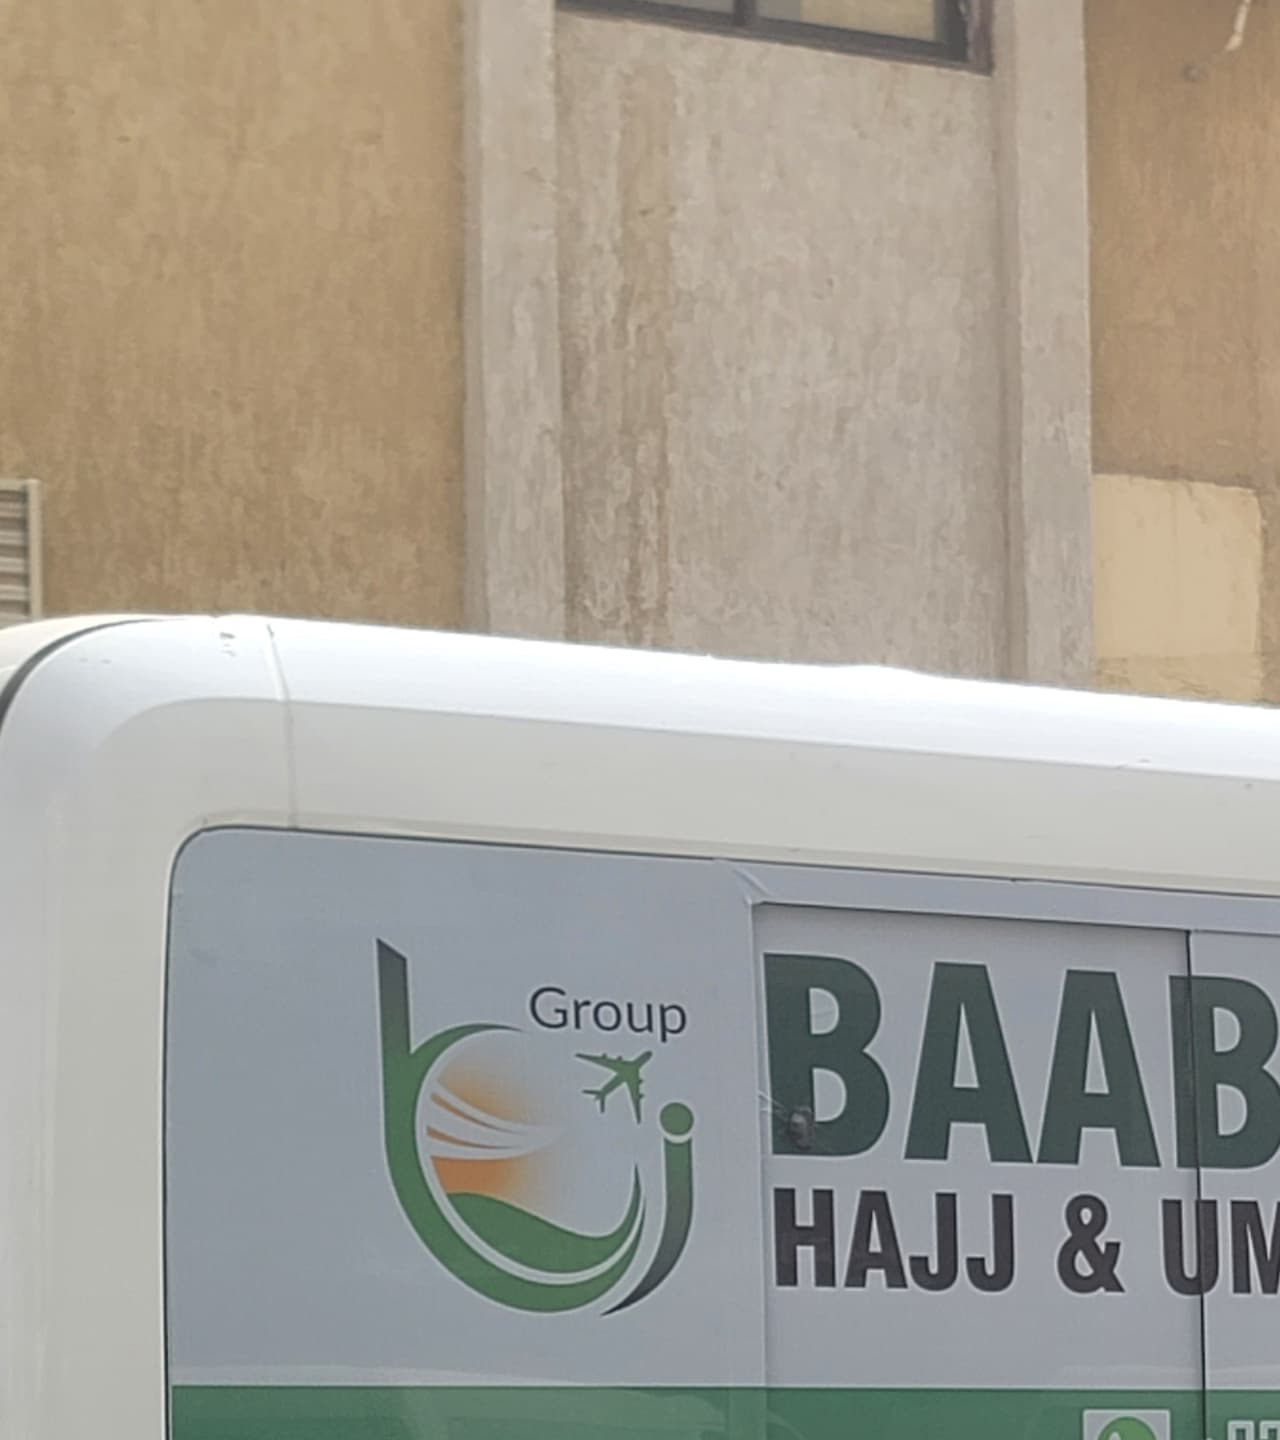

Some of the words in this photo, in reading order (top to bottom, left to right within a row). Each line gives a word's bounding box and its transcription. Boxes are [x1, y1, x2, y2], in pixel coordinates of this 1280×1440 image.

[529, 987, 687, 1043] Group
[774, 1187, 1015, 1291] HAJJ
[1056, 1195, 1123, 1293] &
